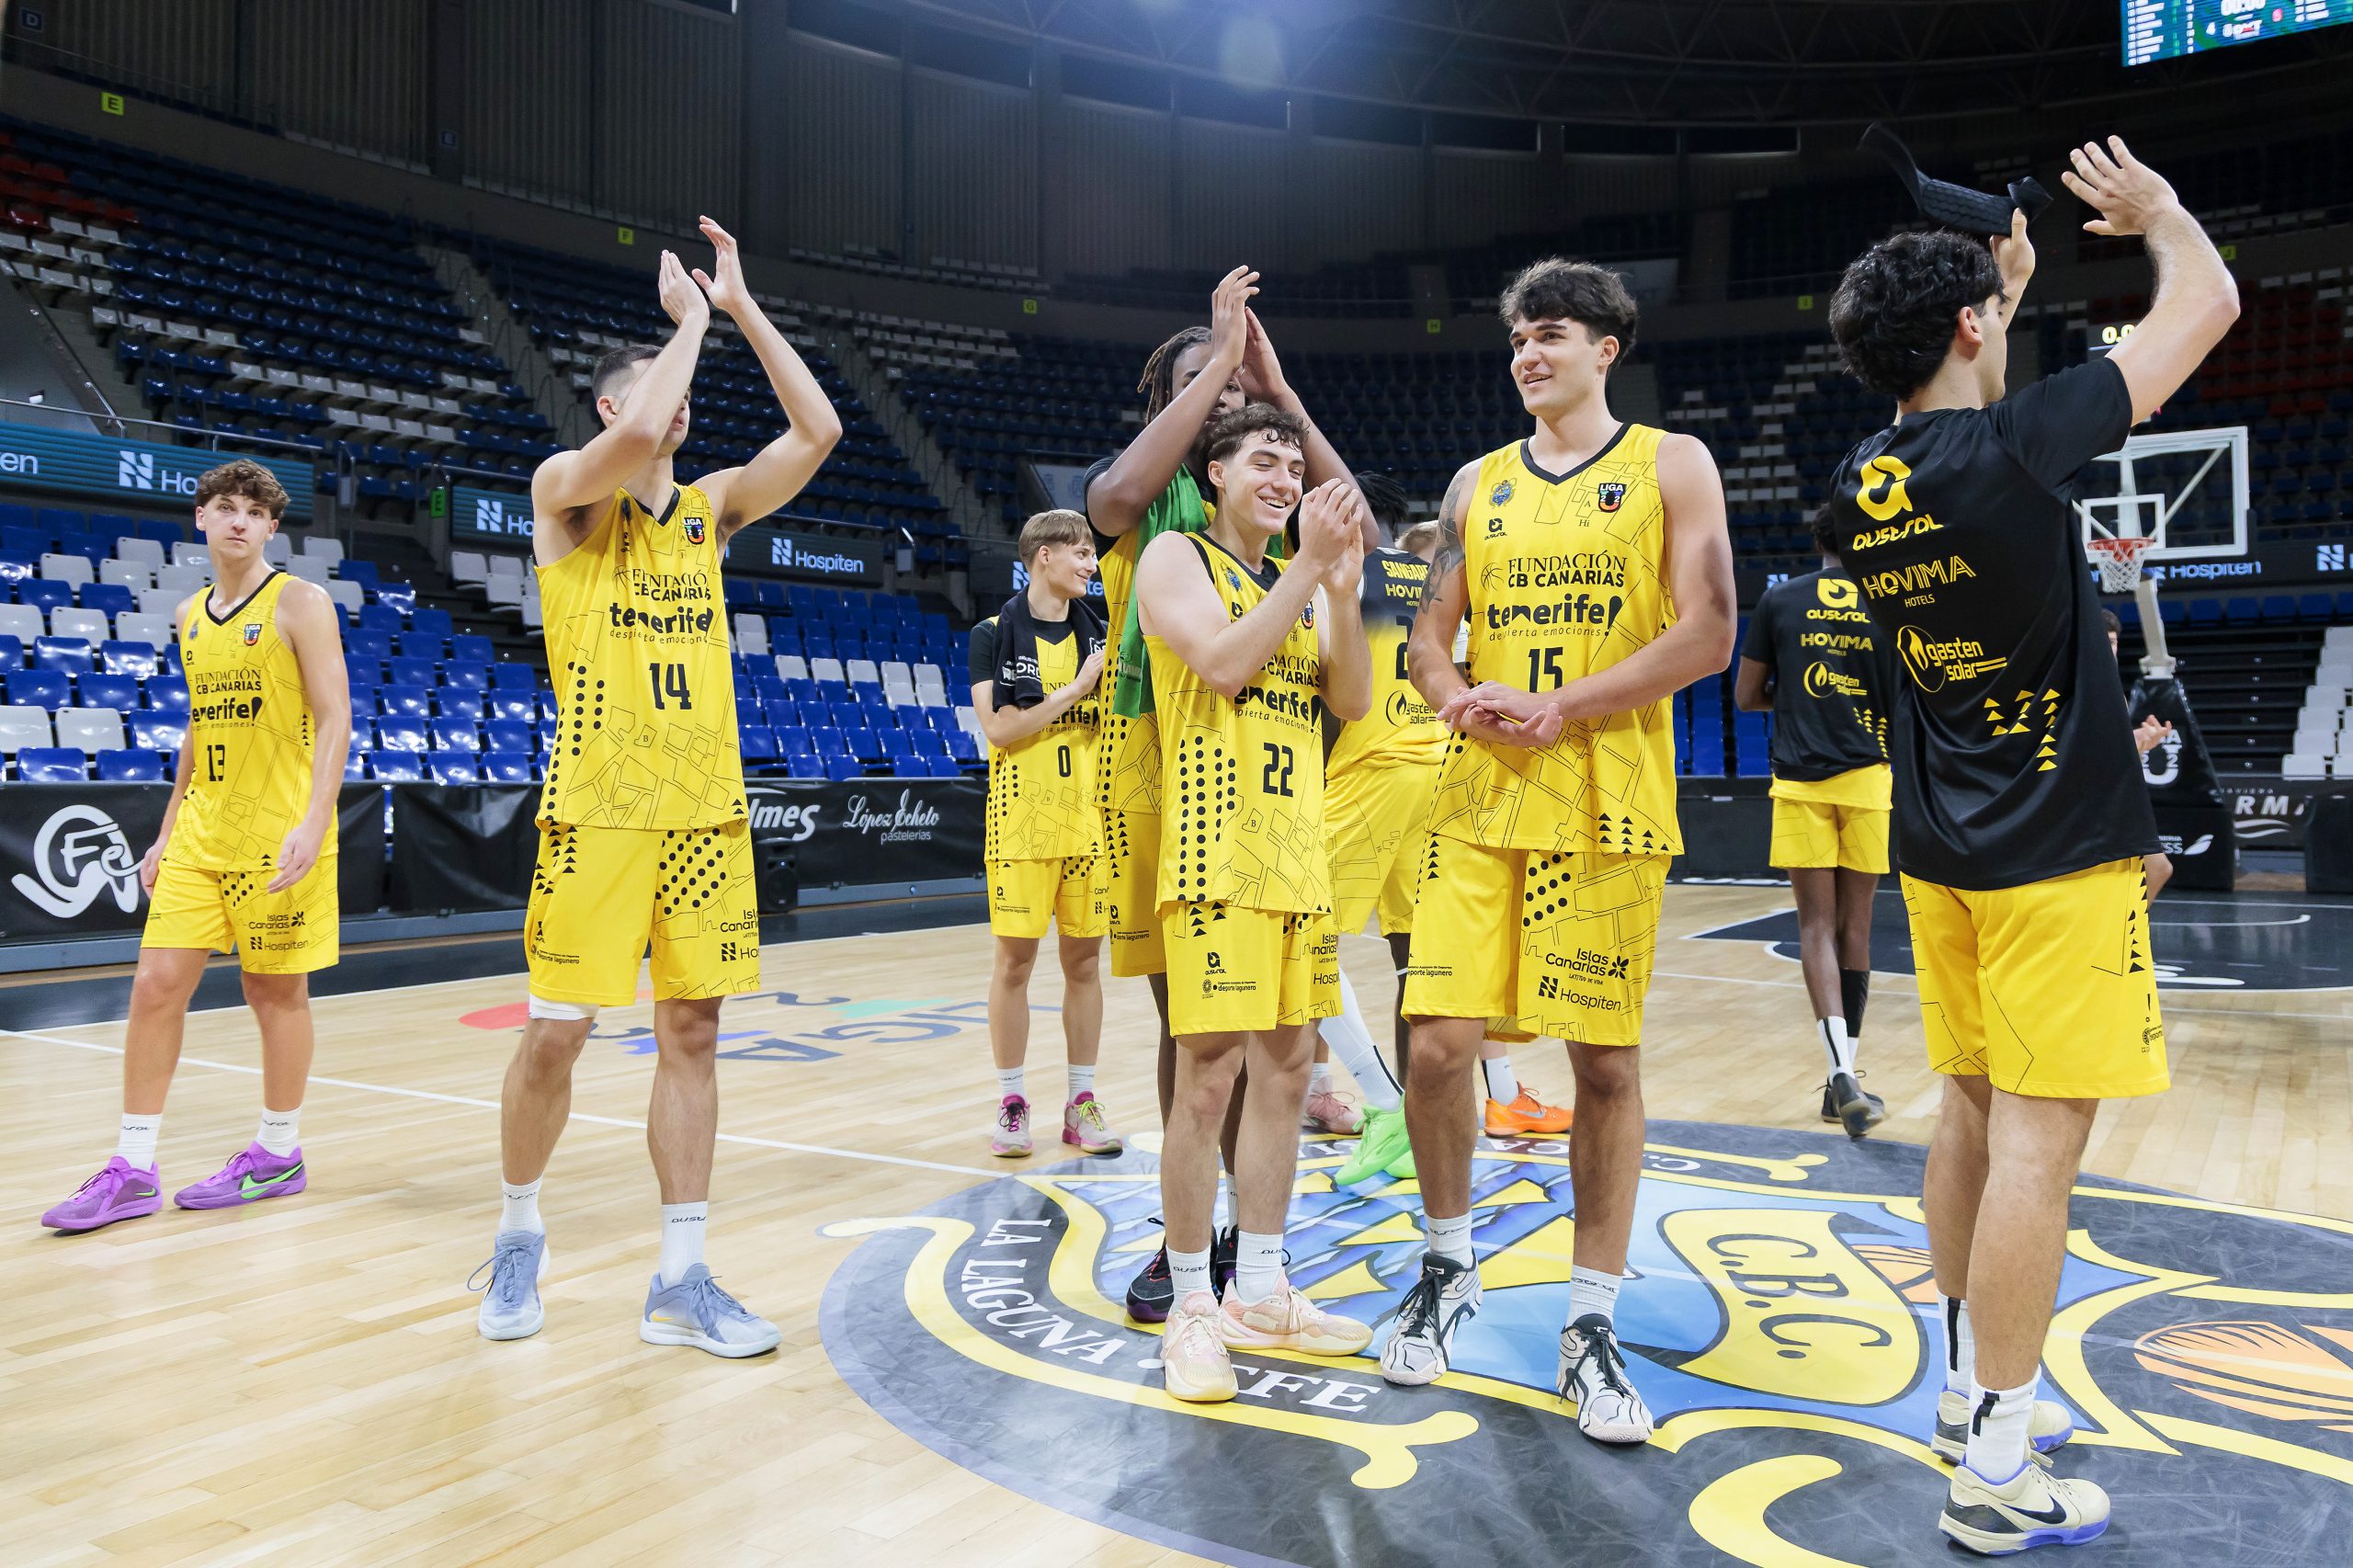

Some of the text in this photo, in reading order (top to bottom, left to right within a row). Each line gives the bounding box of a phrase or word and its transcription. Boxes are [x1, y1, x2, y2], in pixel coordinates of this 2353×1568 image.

[108, 97, 119, 110] E
[1600, 483, 1624, 493] LIGA
[684, 517, 702, 526] LIGA
[1578, 518, 1590, 528] Hi
[1852, 514, 1944, 551] austral
[795, 550, 864, 574] Hospiten
[1508, 550, 1628, 573] FUNDACIÓN
[1508, 570, 1625, 588] CB CANARIAS
[1862, 555, 1976, 599] HOVIMA
[1904, 594, 1936, 608] HOTELS
[1806, 608, 1871, 624] austral
[1543, 627, 1601, 638] emociones
[1801, 632, 1873, 652] HOVIMA
[1926, 636, 1984, 667] gasten
[195, 665, 262, 685] FUNDACIÓN
[1529, 646, 1563, 693] 15
[1828, 671, 1859, 687] gasten
[1946, 659, 1977, 682] solar
[196, 680, 262, 695] CB CANARIAS
[649, 663, 692, 710] 14
[1410, 715, 1427, 725] solar
[207, 744, 226, 781] 13
[1057, 744, 1072, 778] 0
[1263, 742, 1294, 798] 22
[843, 794, 895, 835] López
[1251, 819, 1256, 827] B
[248, 920, 290, 930] Canarias
[264, 939, 310, 953] Hospiten
[1546, 953, 1607, 976] Canarias
[1576, 948, 1609, 965] Islas
[1426, 969, 1452, 978] lagunero
[1560, 988, 1621, 1012] Hospiten
[961, 1218, 1128, 1366] LA LAGUNA
